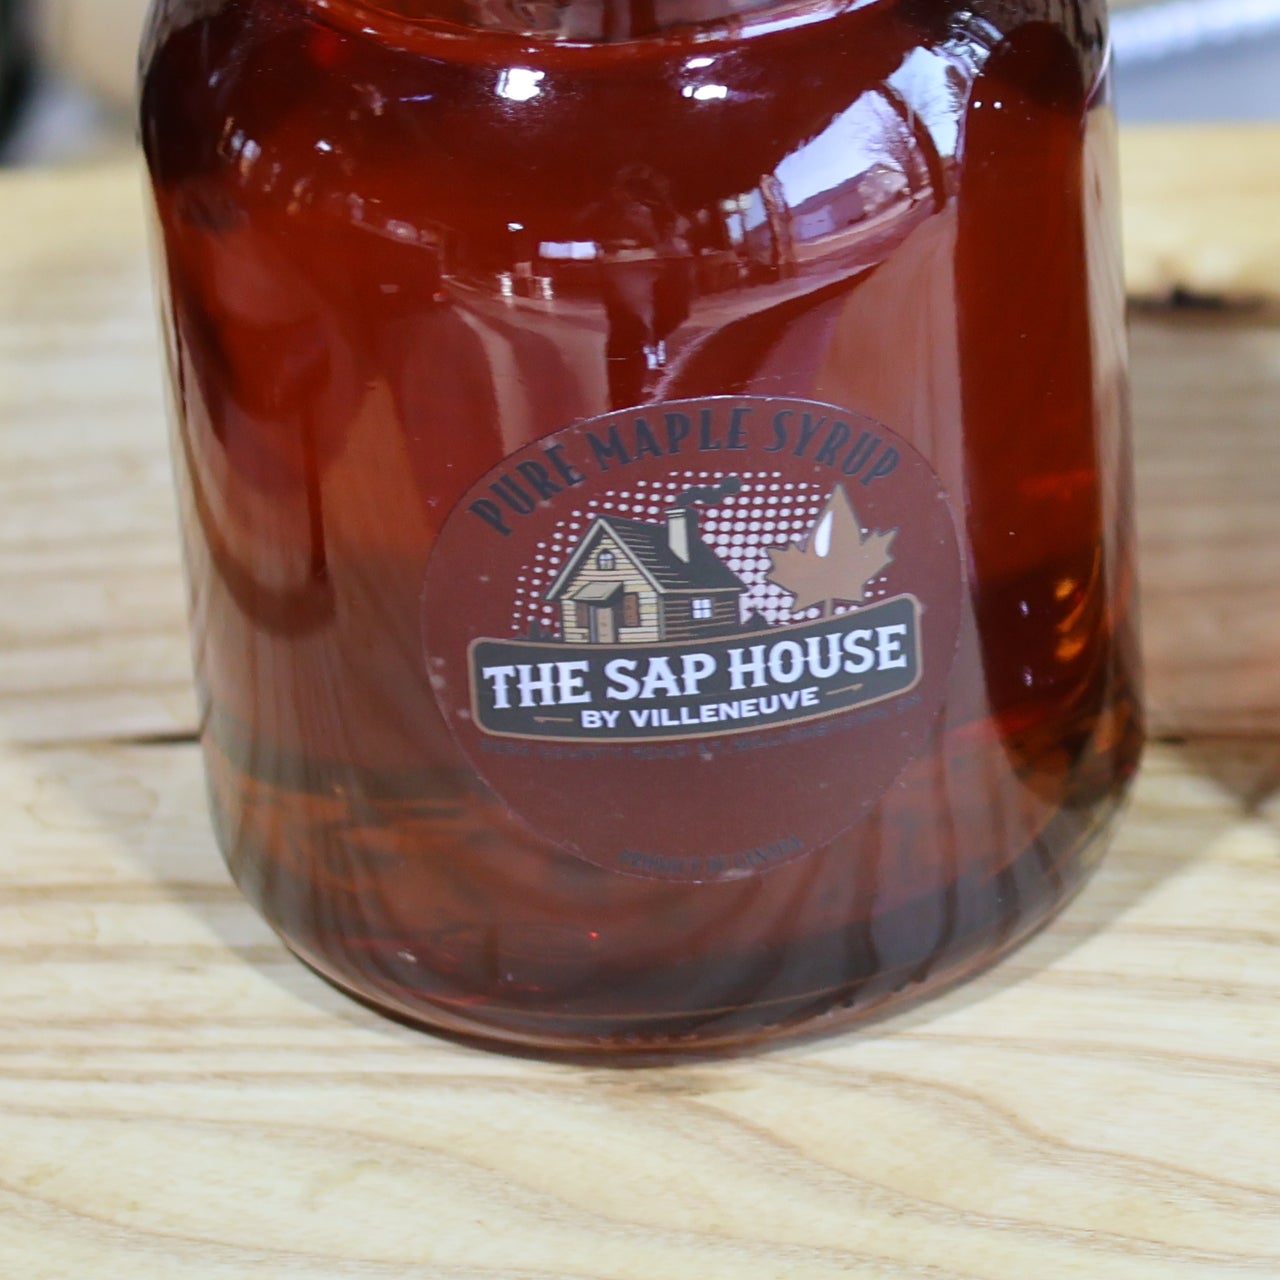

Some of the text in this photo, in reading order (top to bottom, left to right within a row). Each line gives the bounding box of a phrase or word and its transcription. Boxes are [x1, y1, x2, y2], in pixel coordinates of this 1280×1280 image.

[468, 407, 899, 536] PURE MAPLE SYRUP
[483, 624, 907, 708] THE SAP HOUSE
[581, 710, 620, 728] BY
[630, 687, 819, 728] VILLENEUVE
